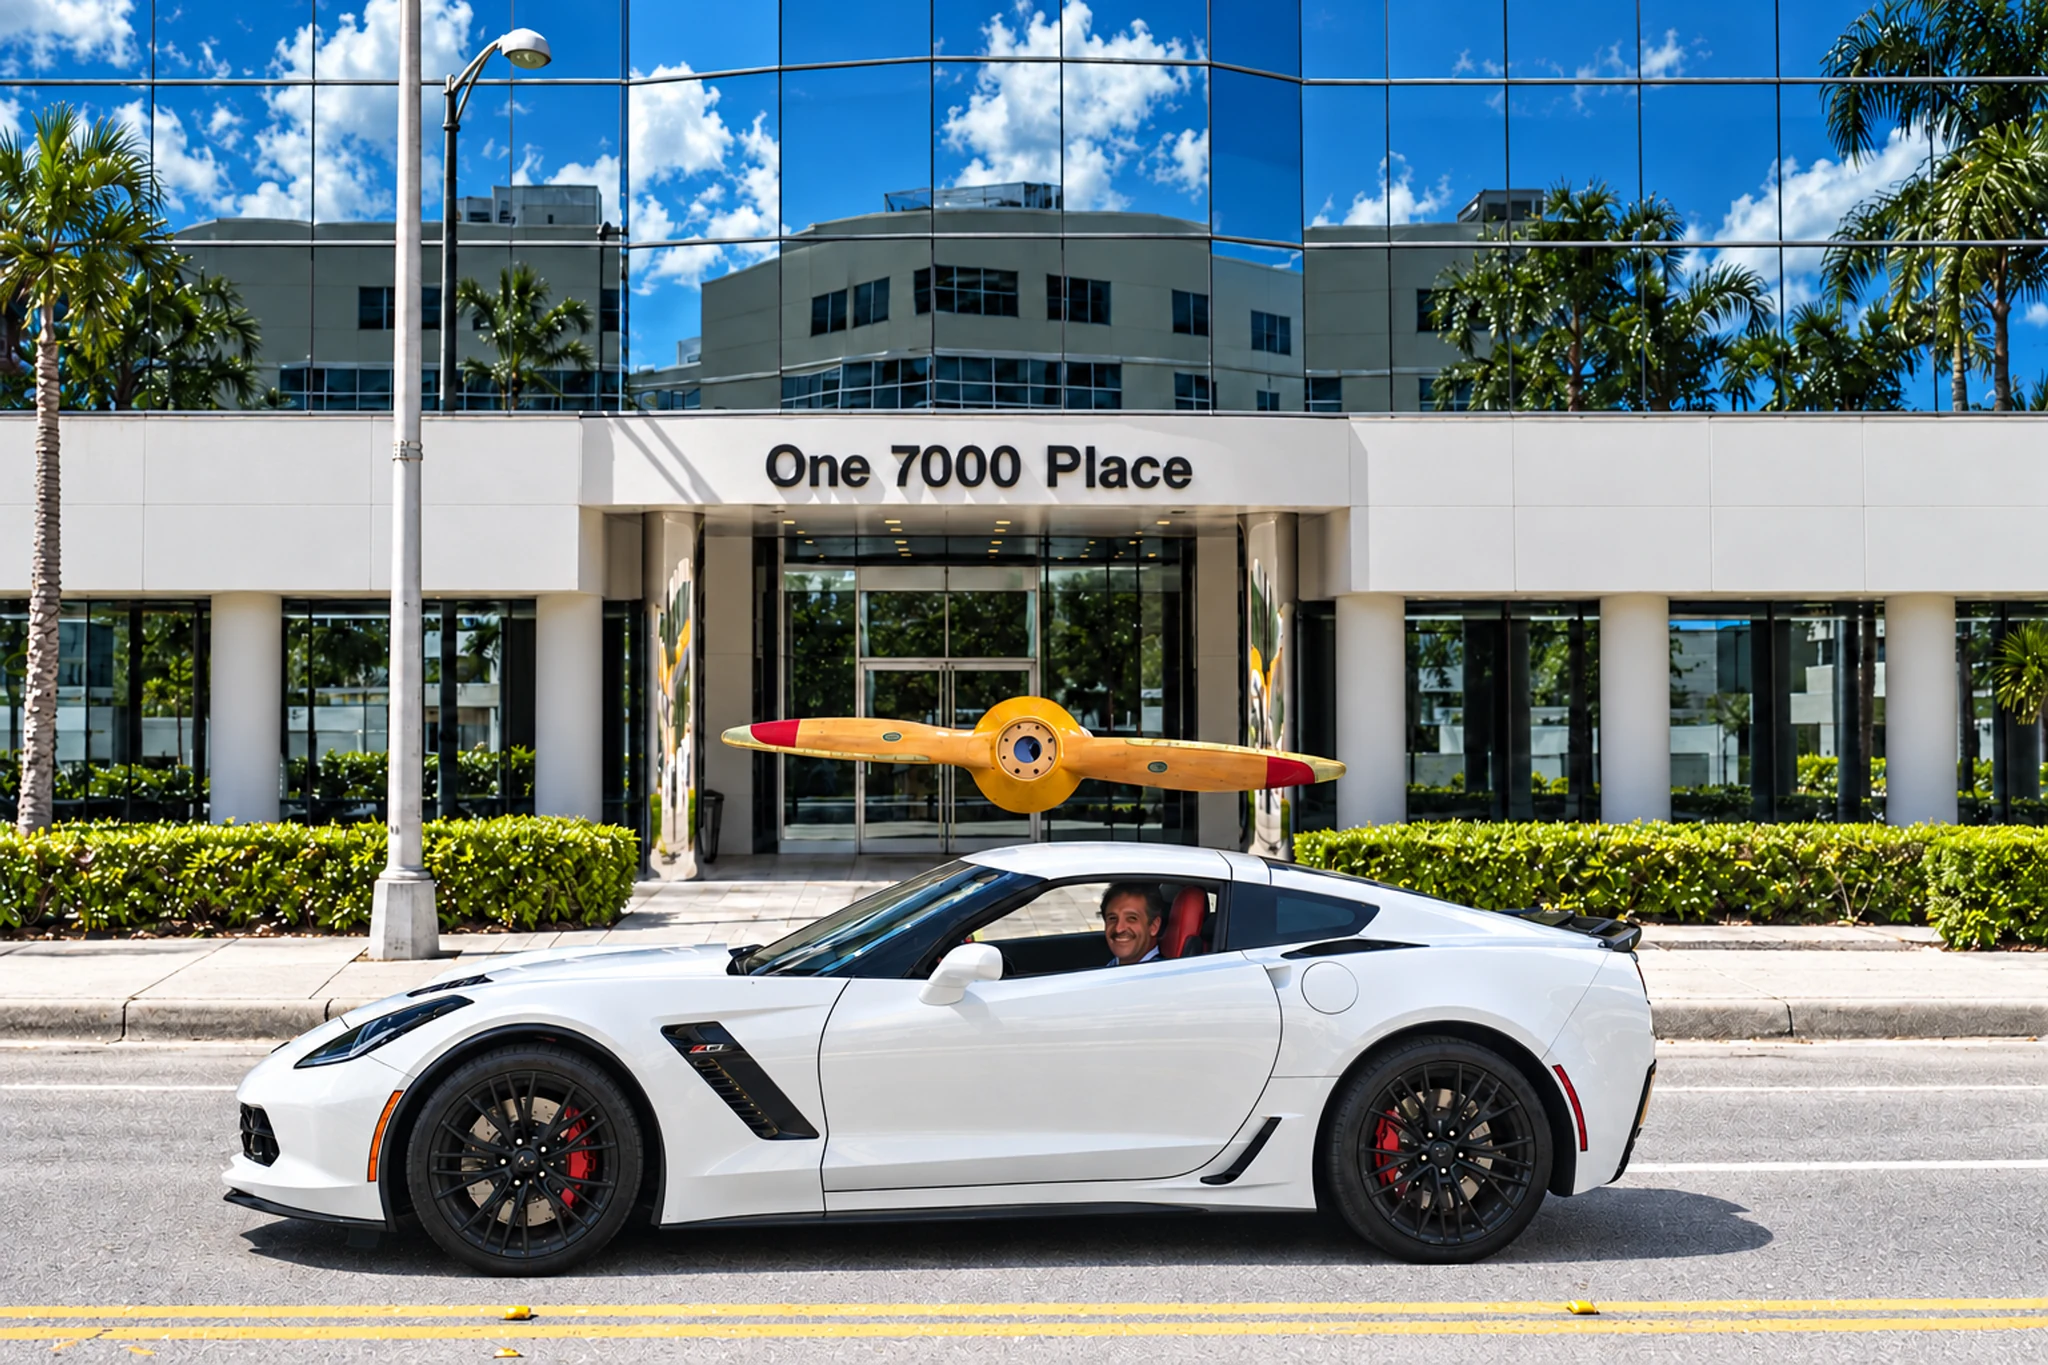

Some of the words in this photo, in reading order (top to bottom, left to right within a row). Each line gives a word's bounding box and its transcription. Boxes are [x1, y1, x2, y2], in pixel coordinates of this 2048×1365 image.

[765, 443, 871, 489] One
[891, 444, 1022, 489] 7000
[1046, 444, 1193, 490] Place
